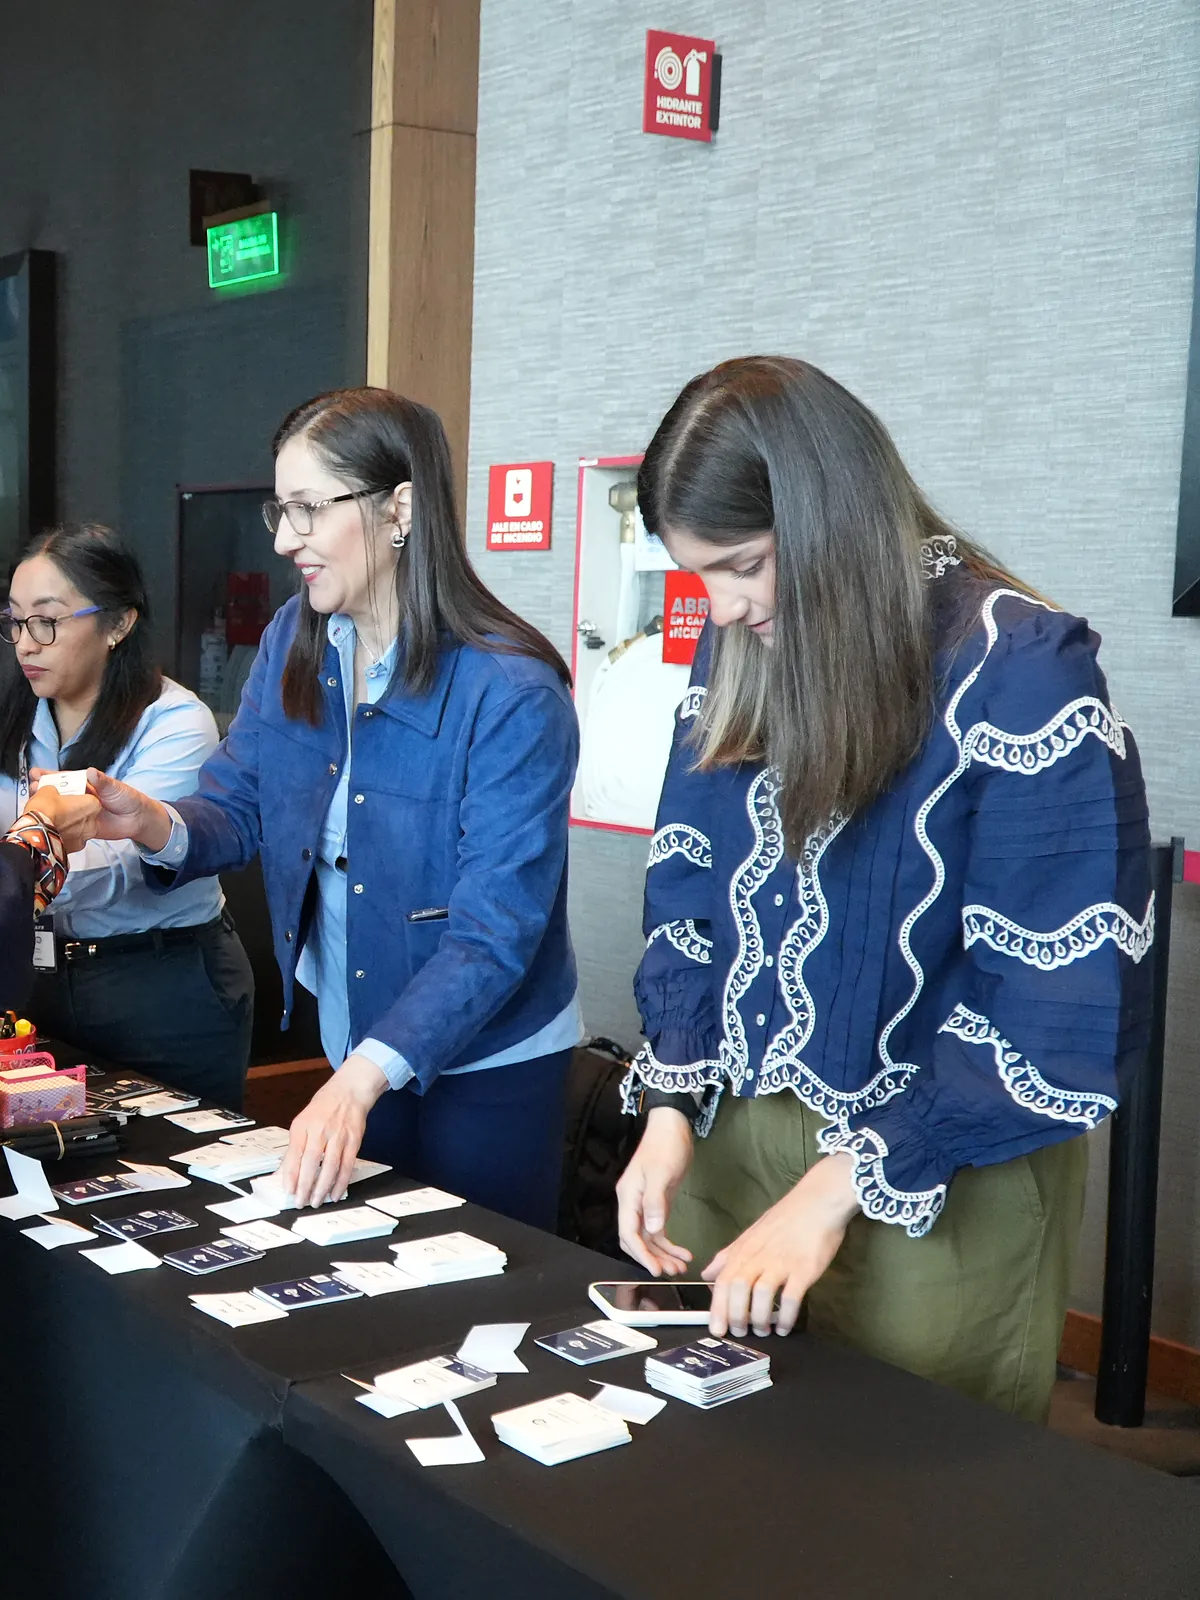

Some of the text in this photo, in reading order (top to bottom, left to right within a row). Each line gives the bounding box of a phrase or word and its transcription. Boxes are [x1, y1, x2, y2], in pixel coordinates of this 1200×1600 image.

[656, 95, 702, 114] HIDRANTE
[656, 110, 701, 129] EXTINTOR
[520, 520, 543, 531] CASO
[491, 532, 543, 543] DE INCENDIO
[671, 597, 710, 615] ABR
[670, 616, 684, 625] EN
[669, 626, 702, 639] INCE
